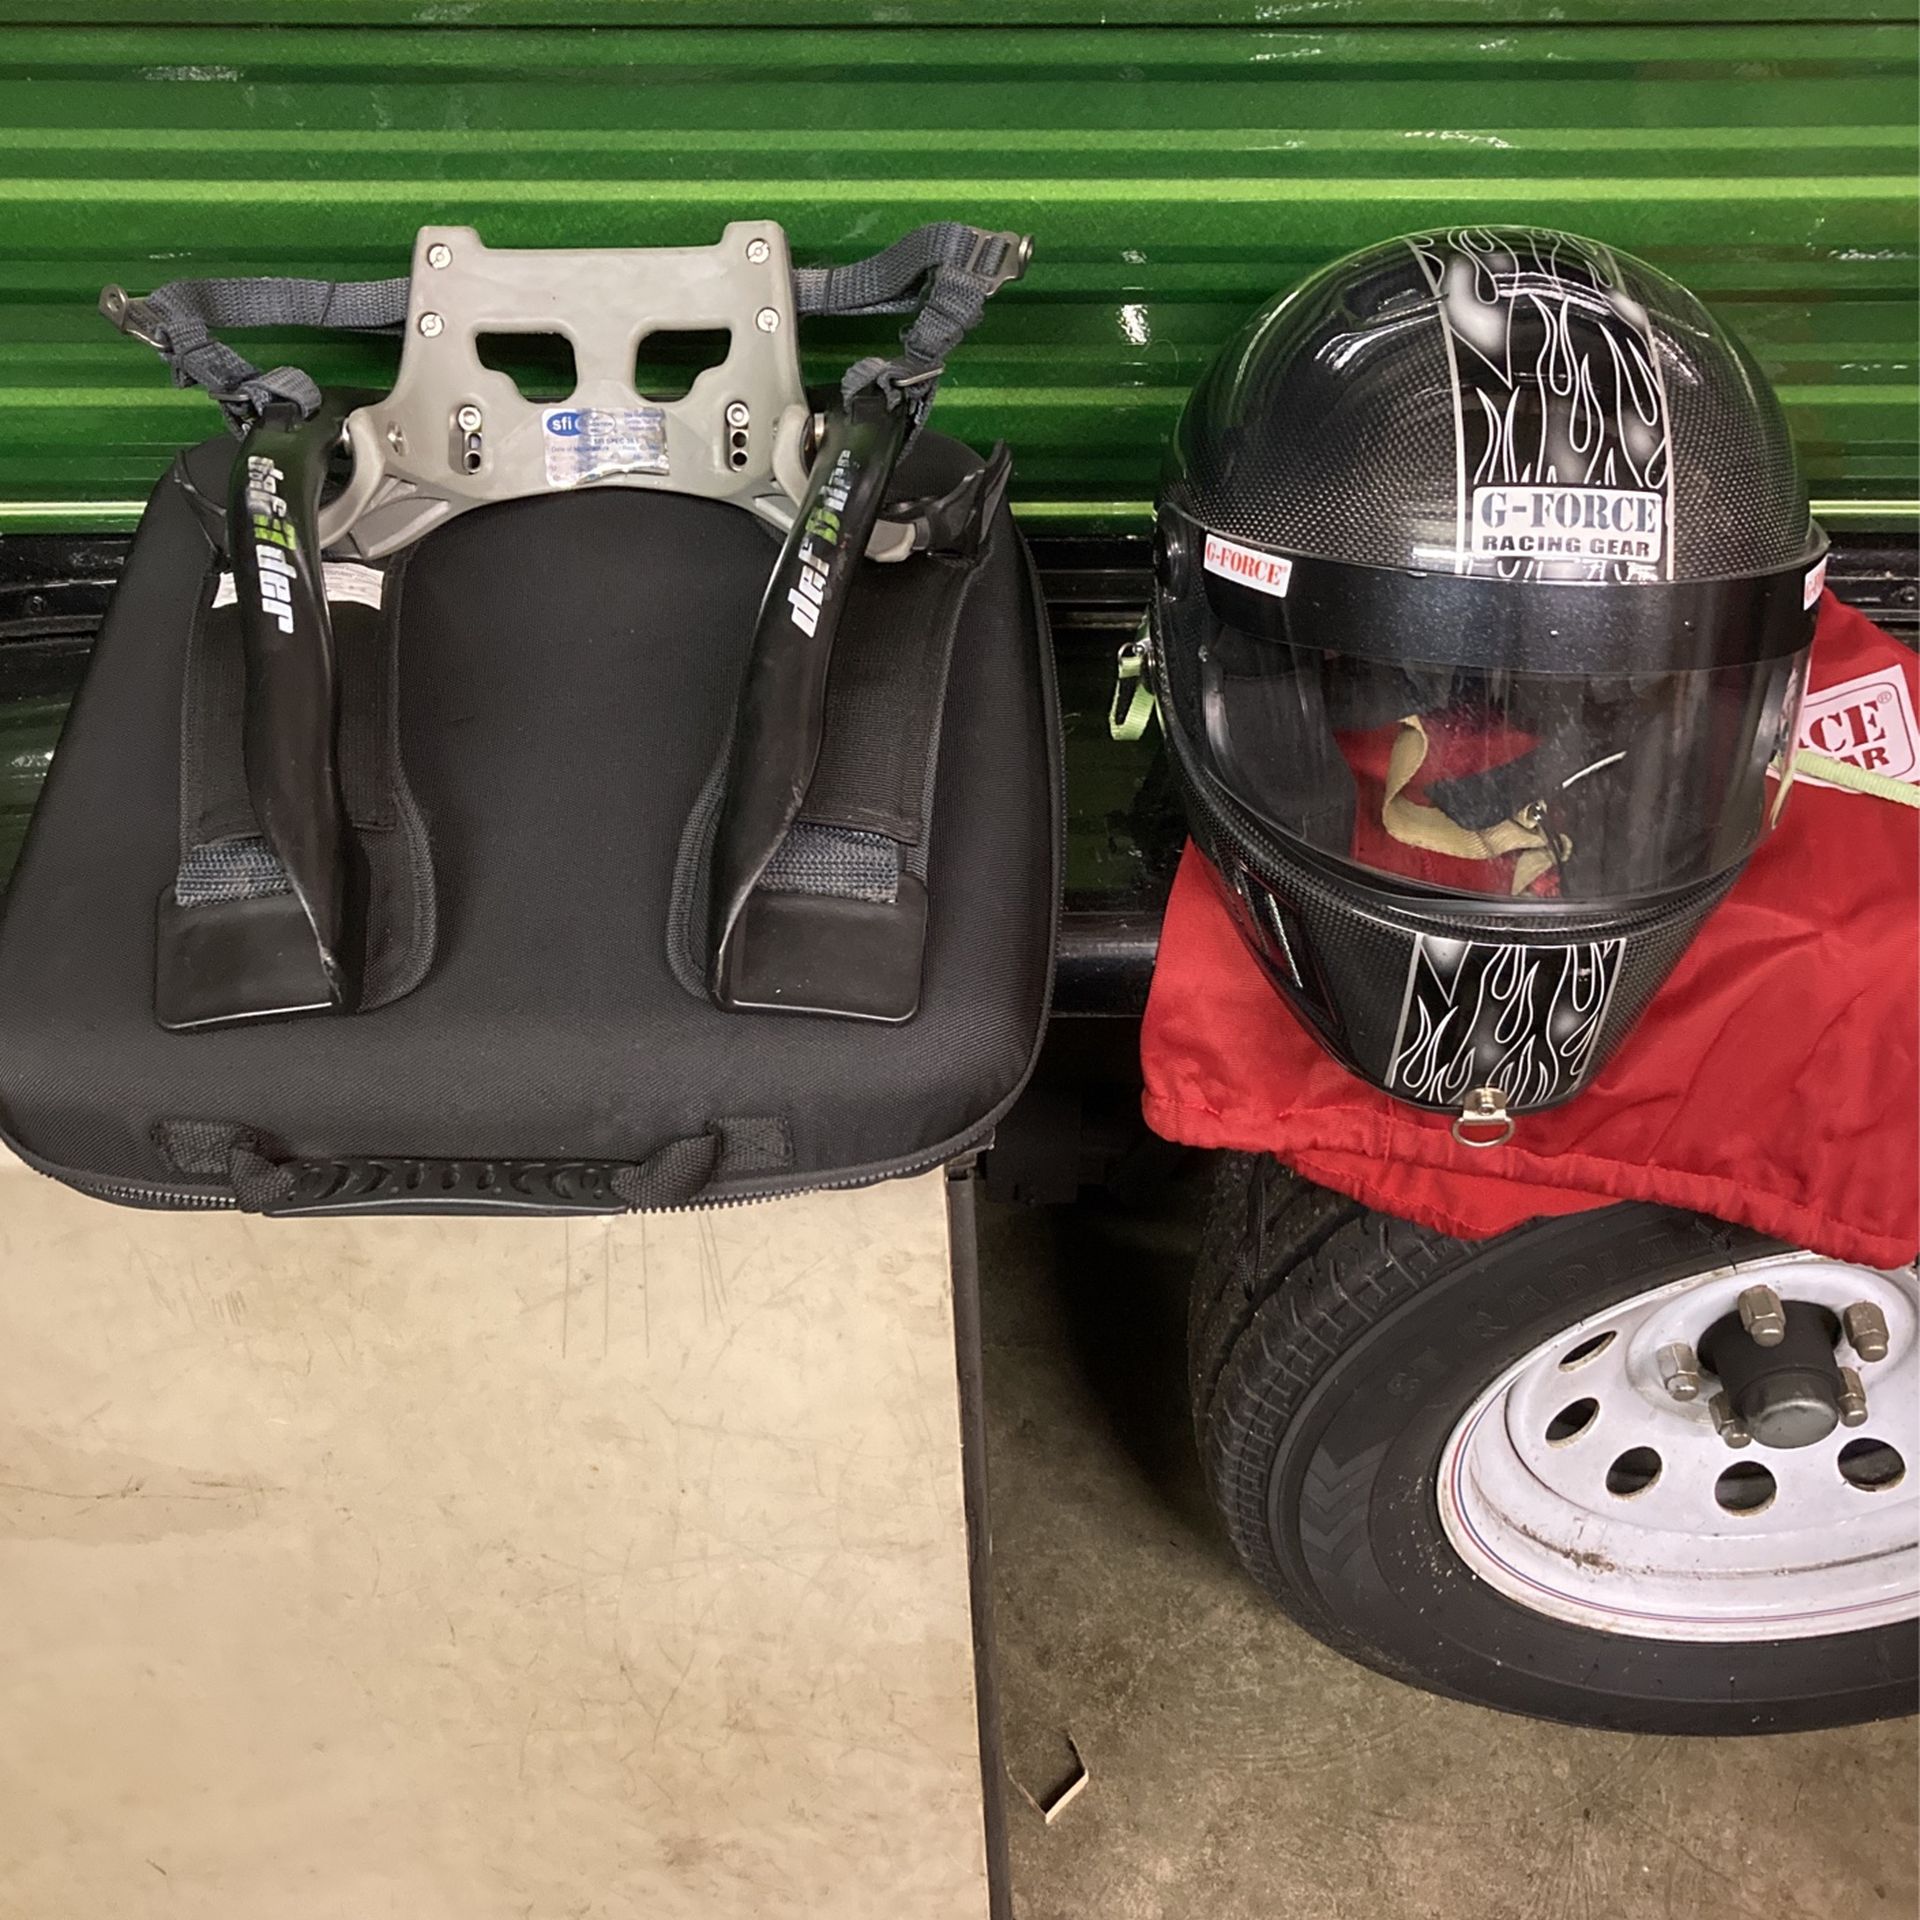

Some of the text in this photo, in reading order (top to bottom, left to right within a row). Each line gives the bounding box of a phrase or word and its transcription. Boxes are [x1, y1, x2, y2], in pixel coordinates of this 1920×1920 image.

[552, 416, 572, 431] sfi
[1481, 492, 1657, 533] G-FORCE
[1206, 541, 1281, 586] G-FORCE
[1482, 535, 1650, 557] RACING GEAR
[1799, 700, 1886, 752] CE
